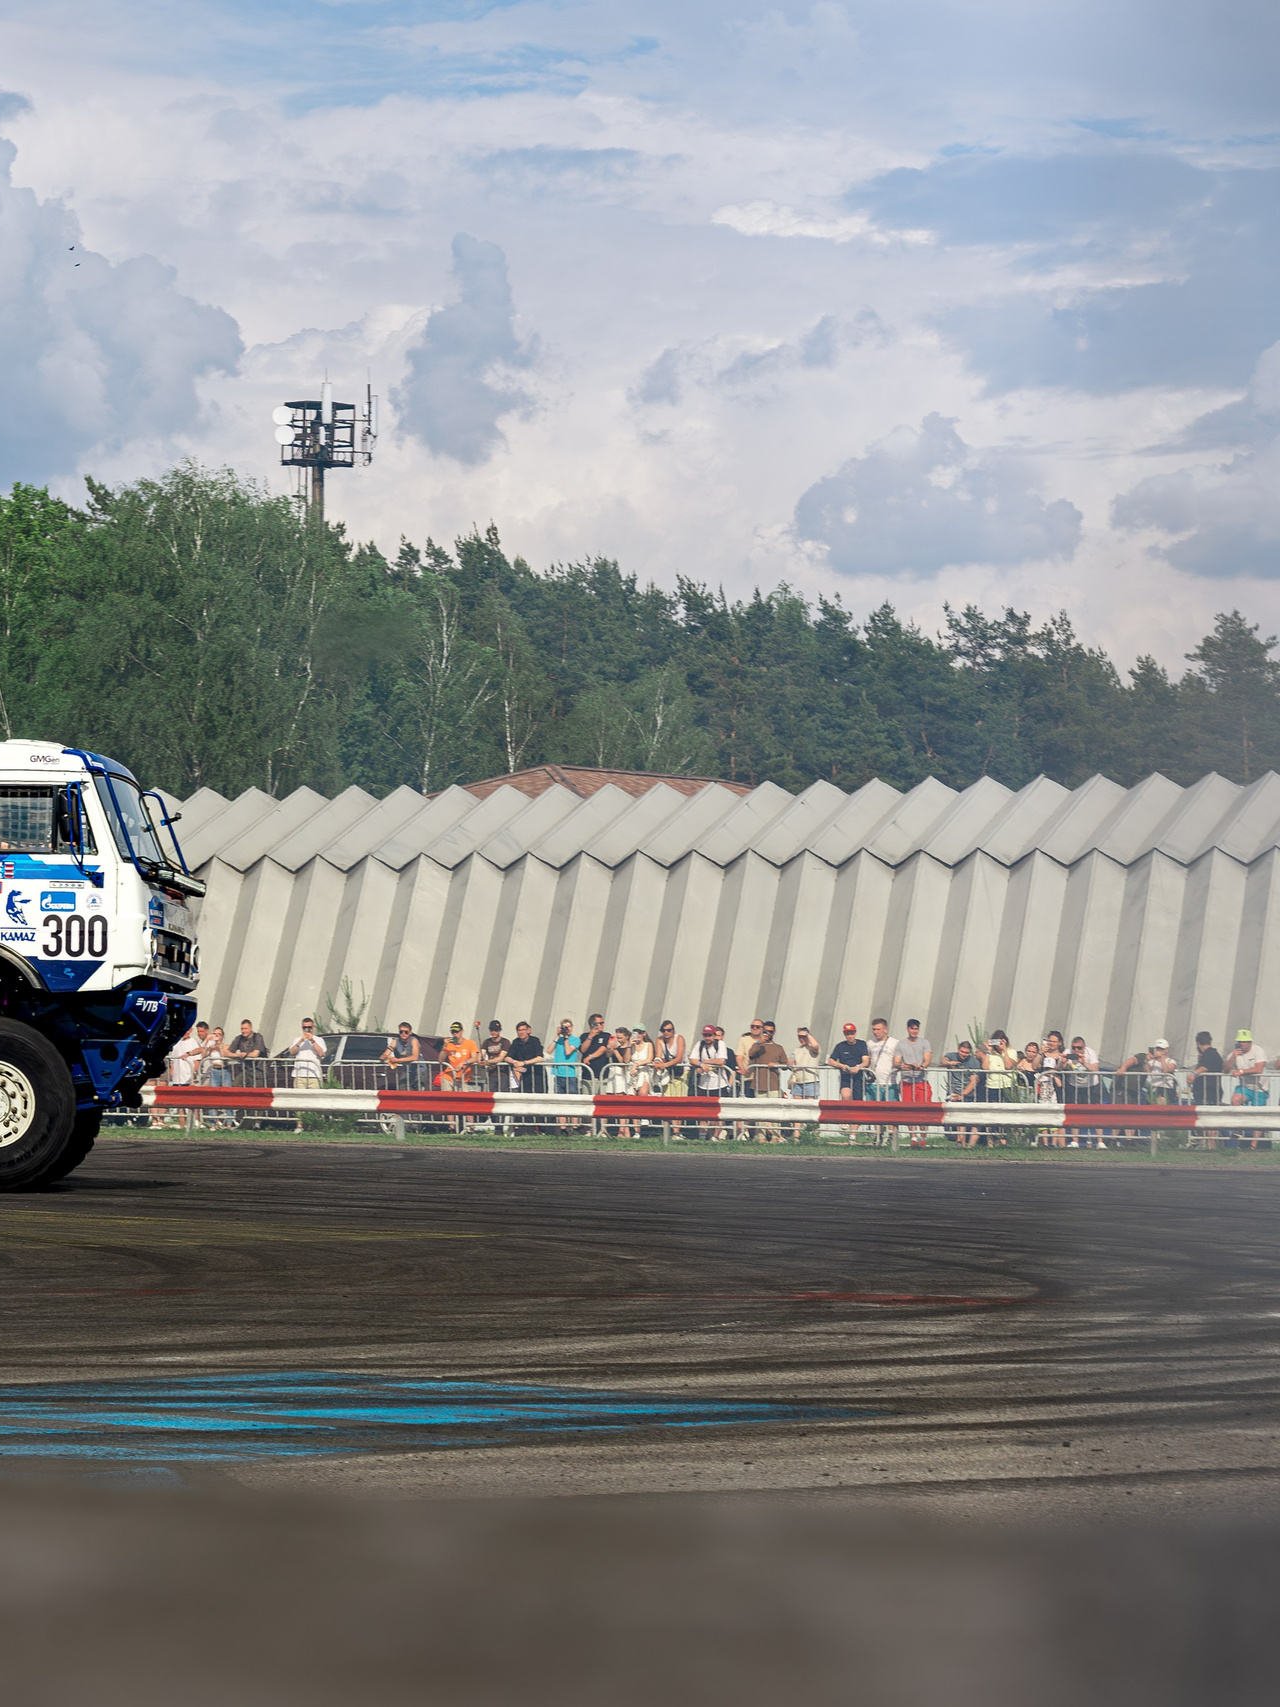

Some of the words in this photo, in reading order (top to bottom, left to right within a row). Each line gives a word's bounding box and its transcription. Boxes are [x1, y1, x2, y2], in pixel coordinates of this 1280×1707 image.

[0, 931, 36, 942] KAMAZ
[42, 914, 108, 958] 300
[141, 1000, 159, 1013] VTB
